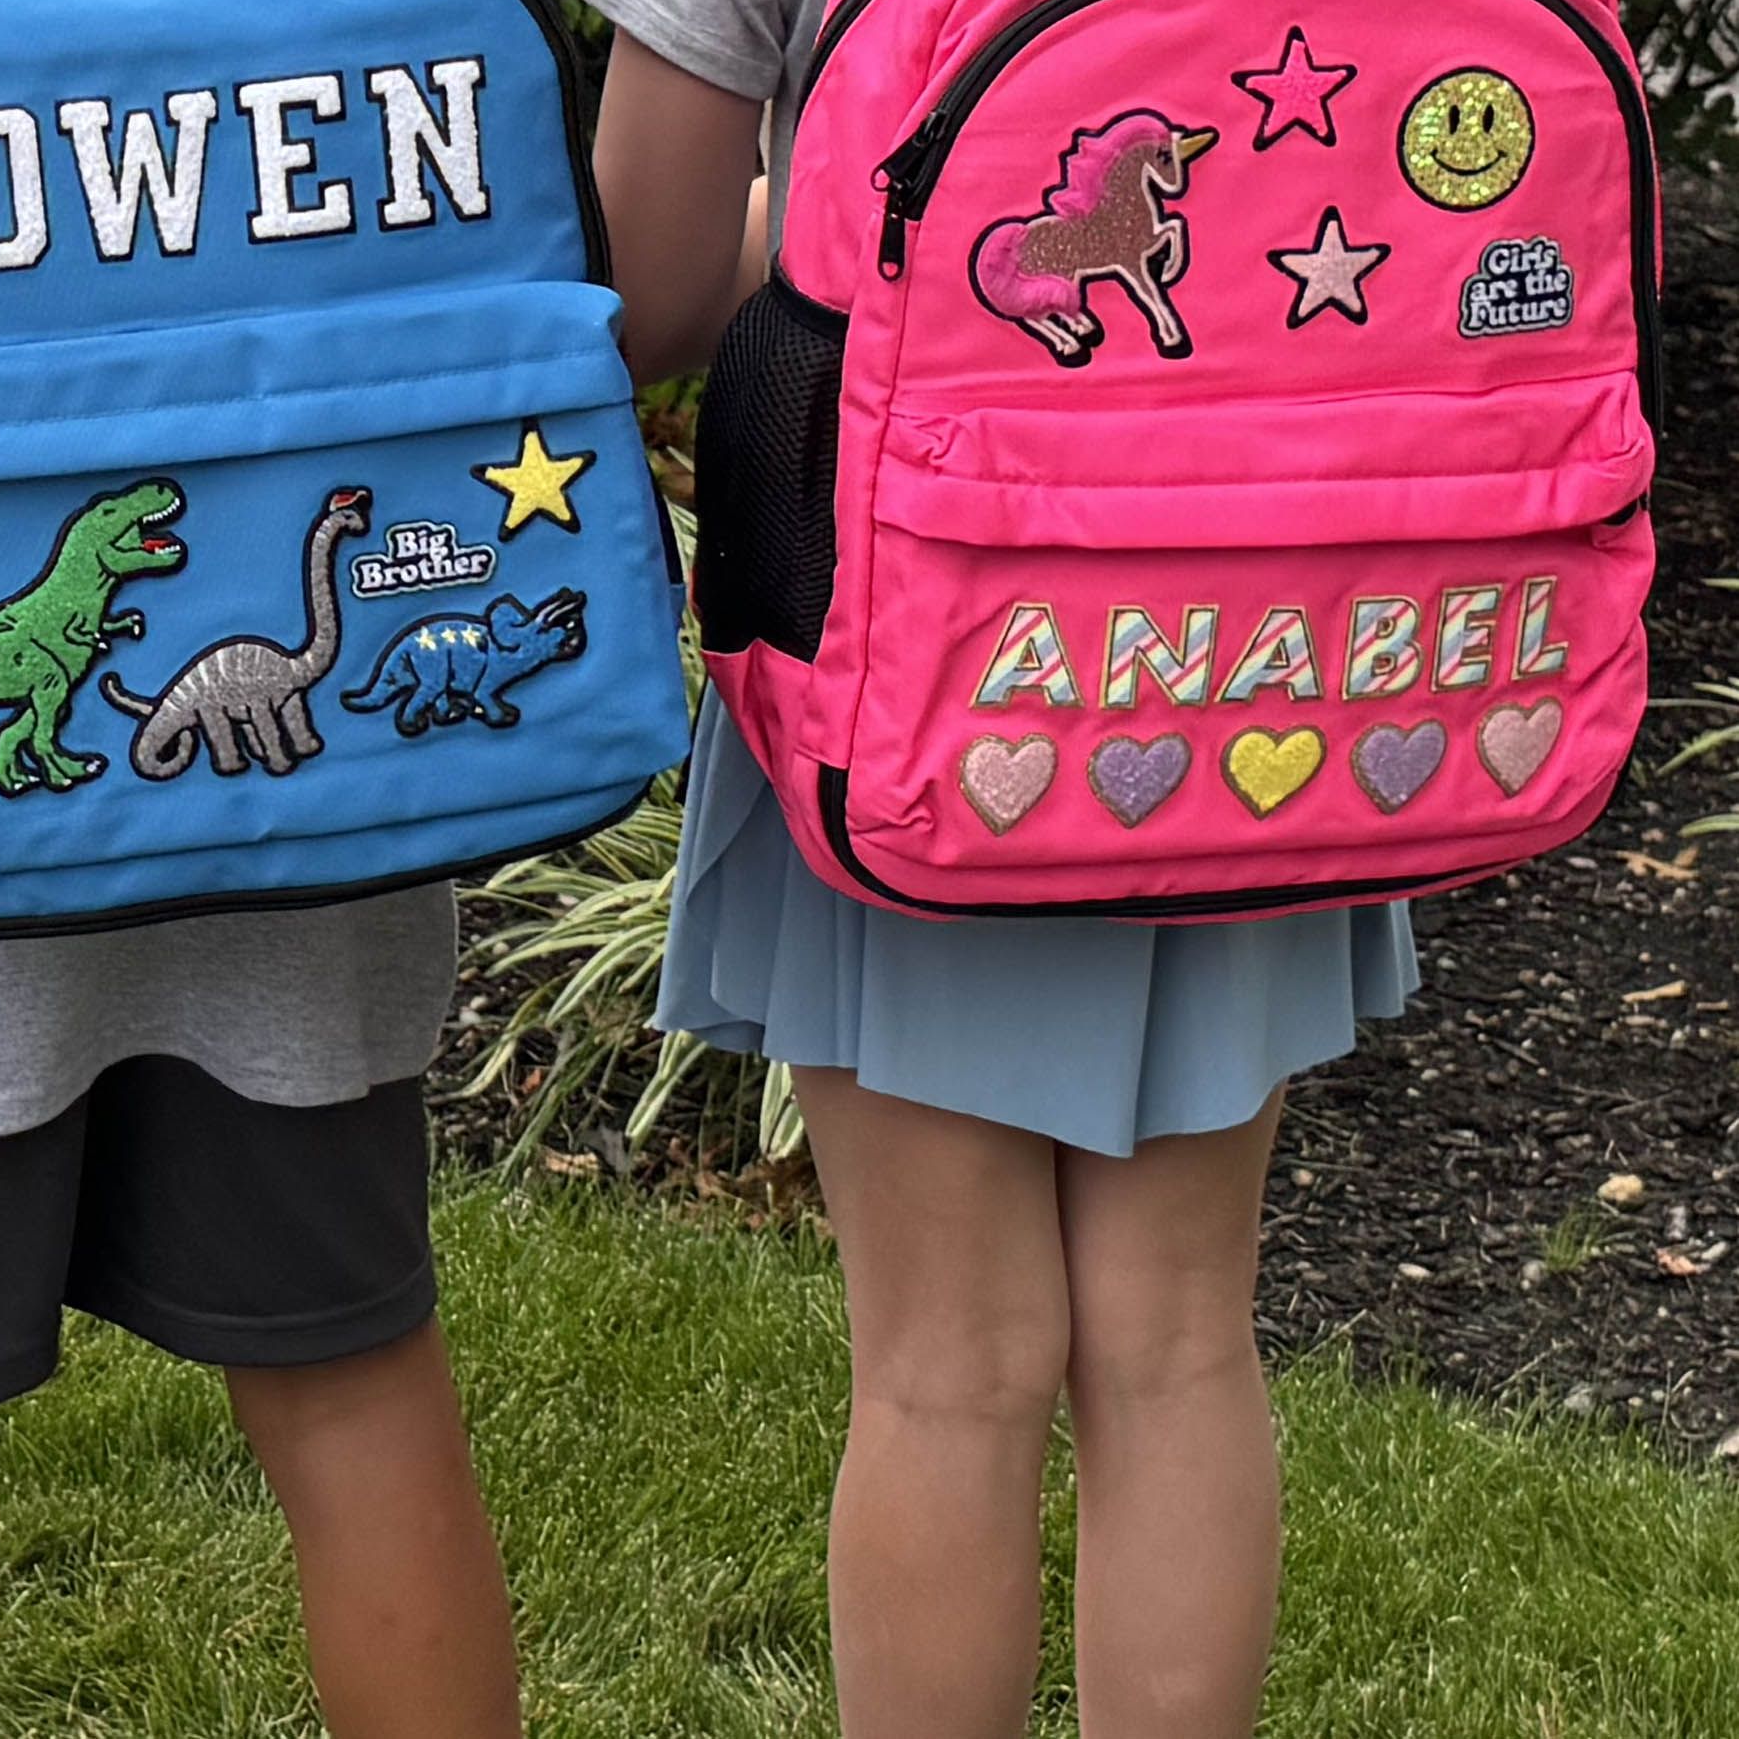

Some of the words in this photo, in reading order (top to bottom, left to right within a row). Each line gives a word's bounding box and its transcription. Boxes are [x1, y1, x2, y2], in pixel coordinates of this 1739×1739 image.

[1488, 243, 1556, 275] Girls
[1470, 279, 1519, 301] are
[1525, 269, 1567, 295] the
[1468, 297, 1567, 327] Future
[395, 529, 448, 560] Big
[359, 554, 489, 589] Brother
[968, 575, 1569, 710] ANABEL
